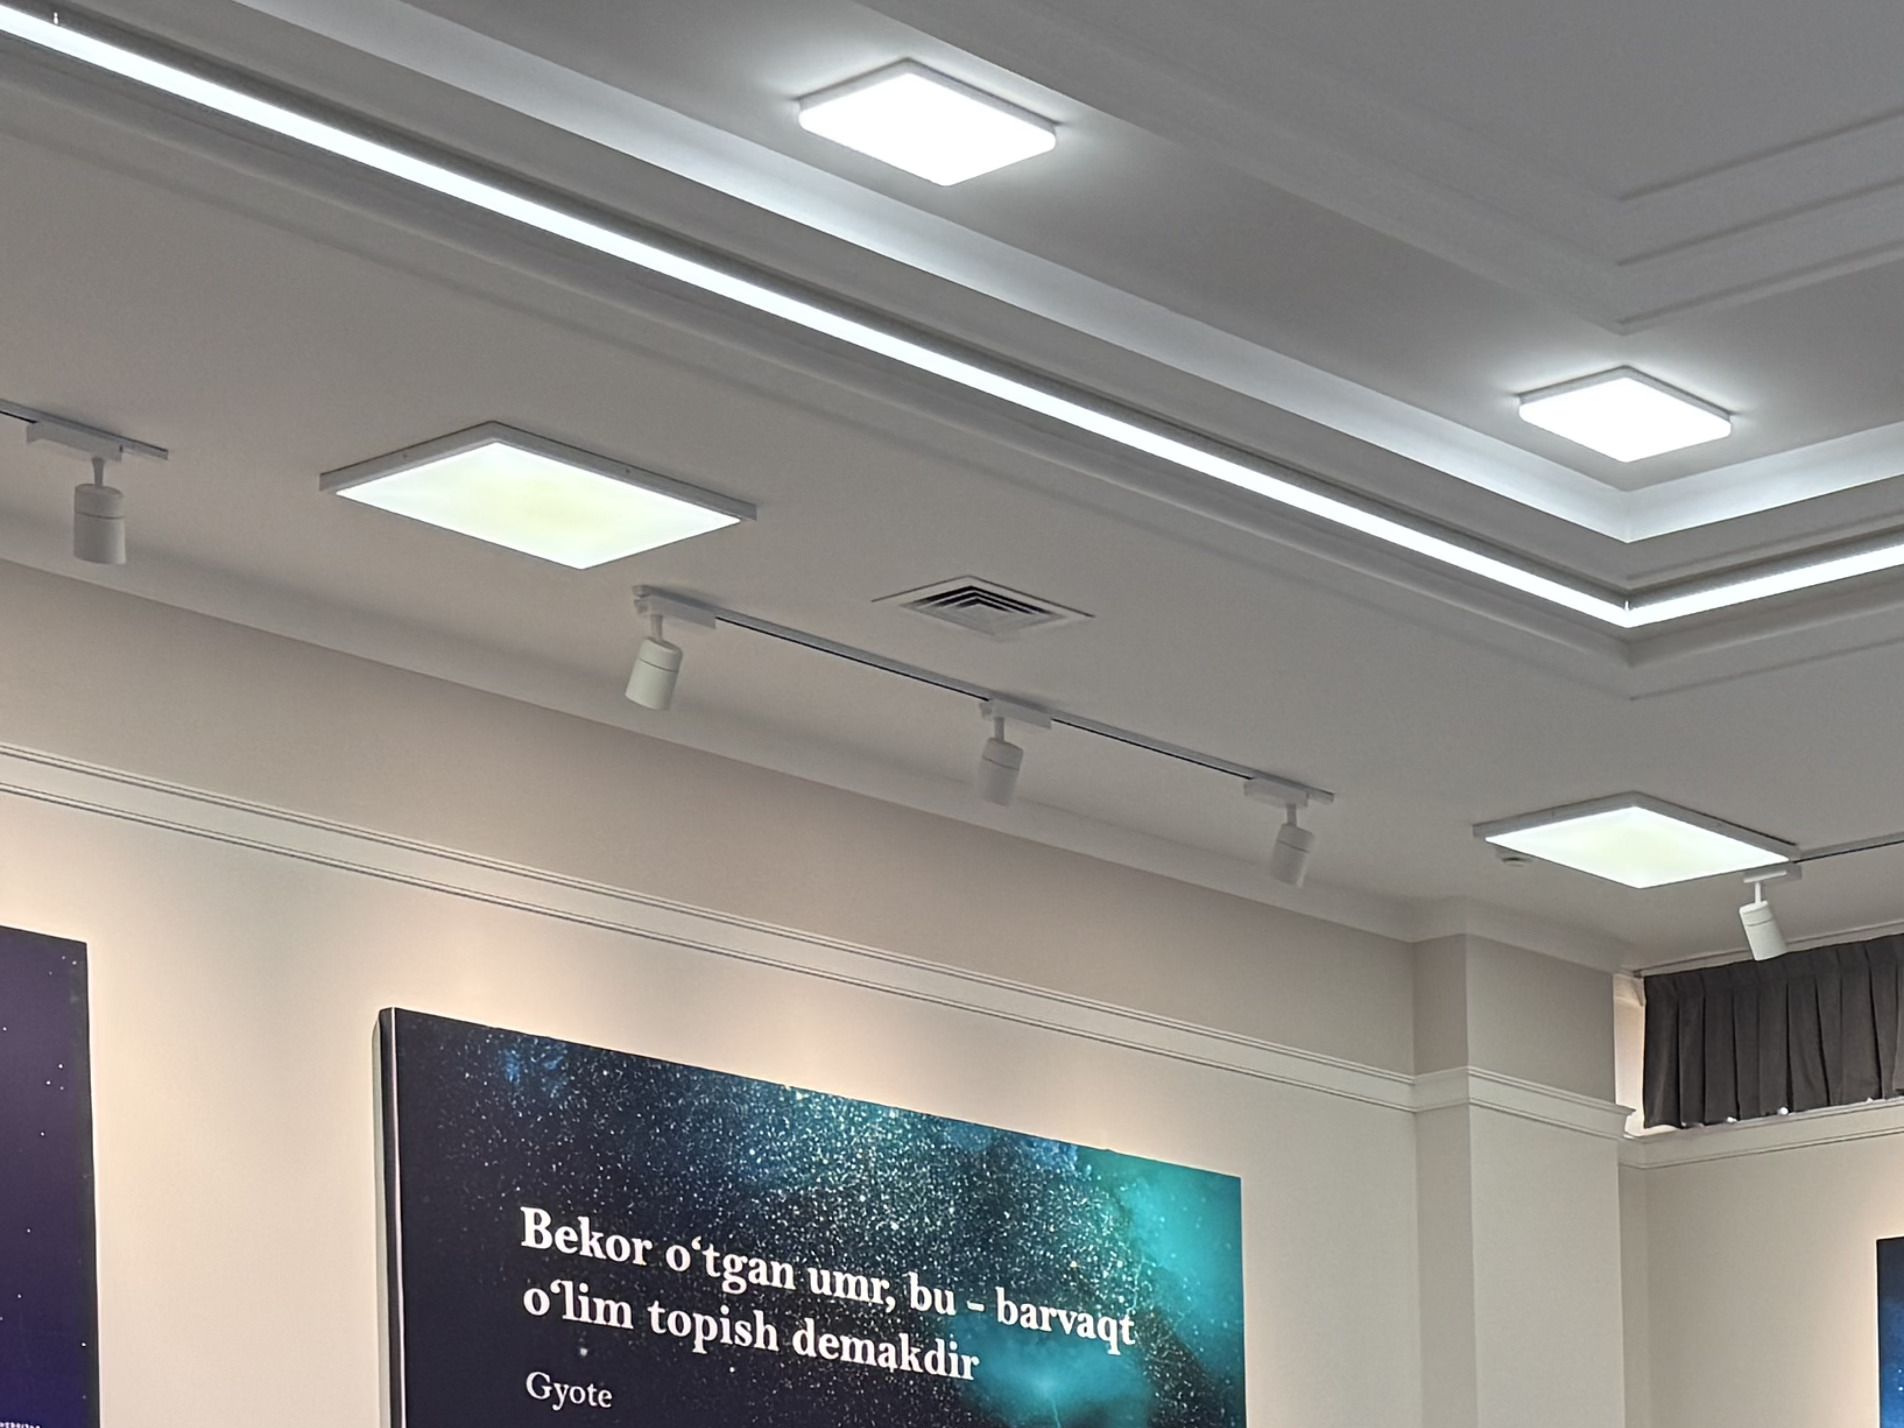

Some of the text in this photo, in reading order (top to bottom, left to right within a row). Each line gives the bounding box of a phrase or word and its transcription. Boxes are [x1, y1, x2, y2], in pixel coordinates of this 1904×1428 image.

[520, 1206, 654, 1267] Bekor
[808, 1269, 897, 1315] umr,
[908, 1272, 957, 1316] bu
[996, 1288, 1137, 1355] barvaqt
[647, 1298, 780, 1356] topish
[792, 1325, 981, 1382] demakdir
[526, 1371, 614, 1410] Gyote
